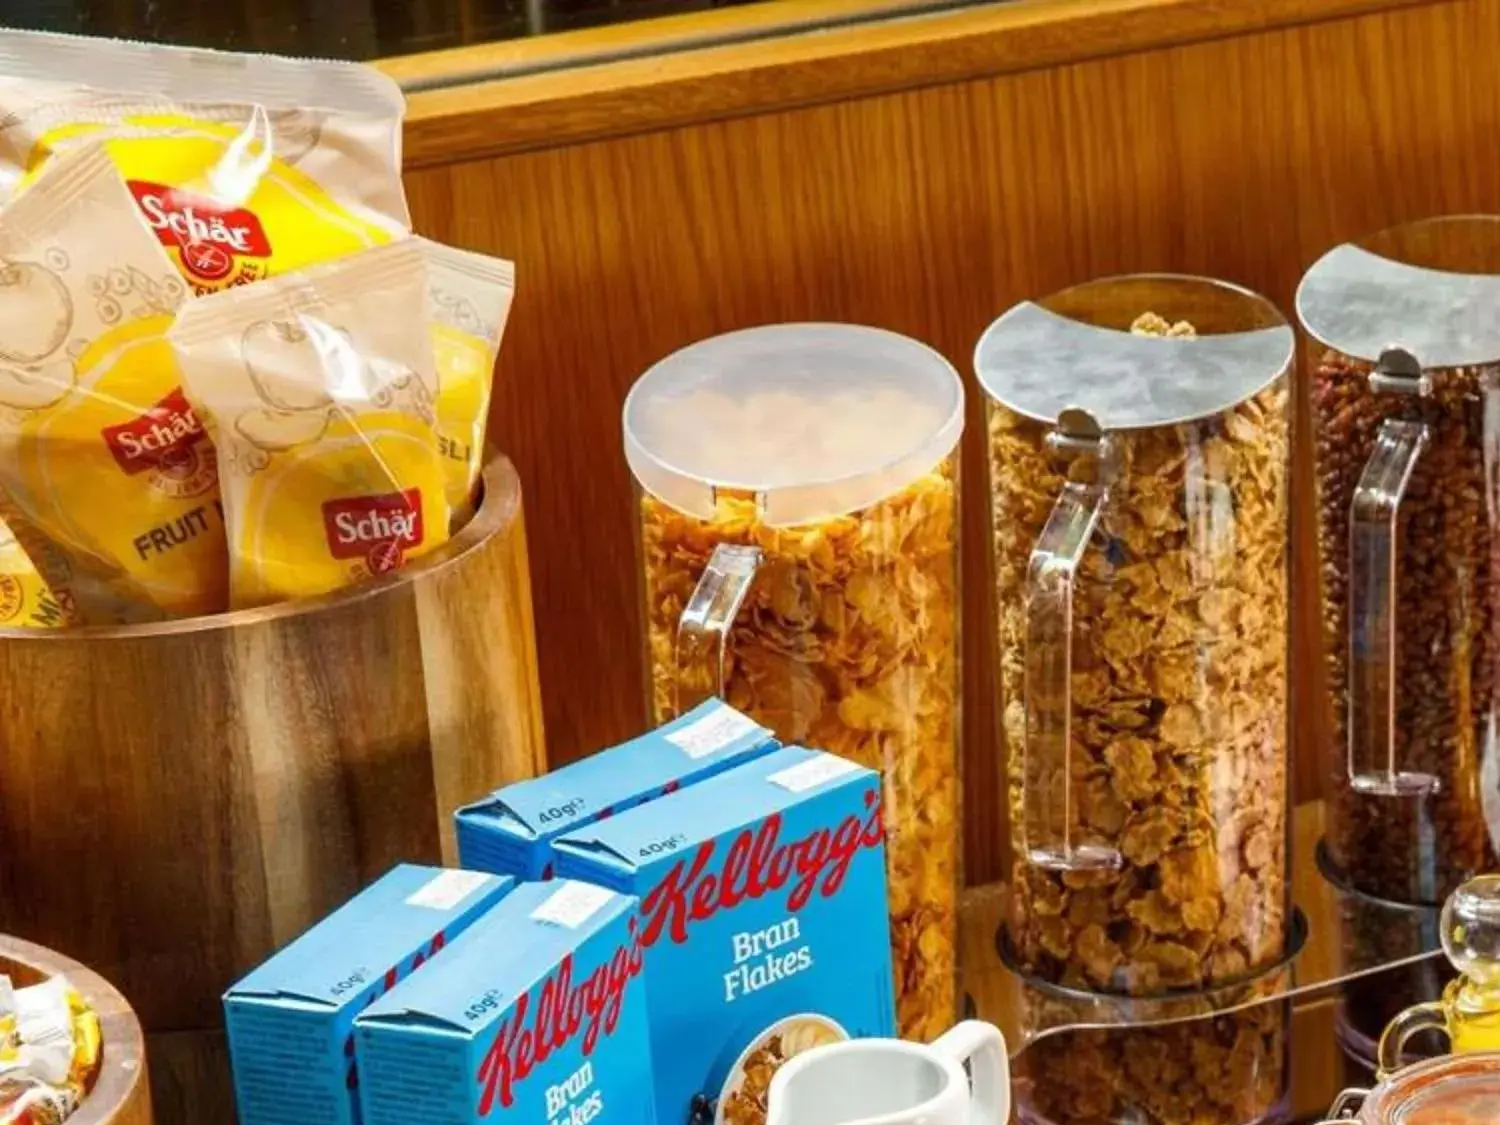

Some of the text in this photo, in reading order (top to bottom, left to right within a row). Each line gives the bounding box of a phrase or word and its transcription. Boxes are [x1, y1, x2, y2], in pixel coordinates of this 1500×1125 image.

[140, 194, 254, 252] Schär
[117, 408, 200, 459] Schär
[133, 506, 209, 561] FRUIT
[334, 508, 417, 544] Schär
[638, 788, 887, 947] Kellogg's
[732, 916, 801, 965] Bran
[723, 945, 814, 1002] Flakes
[476, 915, 643, 1118] Kellogg's
[545, 1060, 594, 1121] Bran
